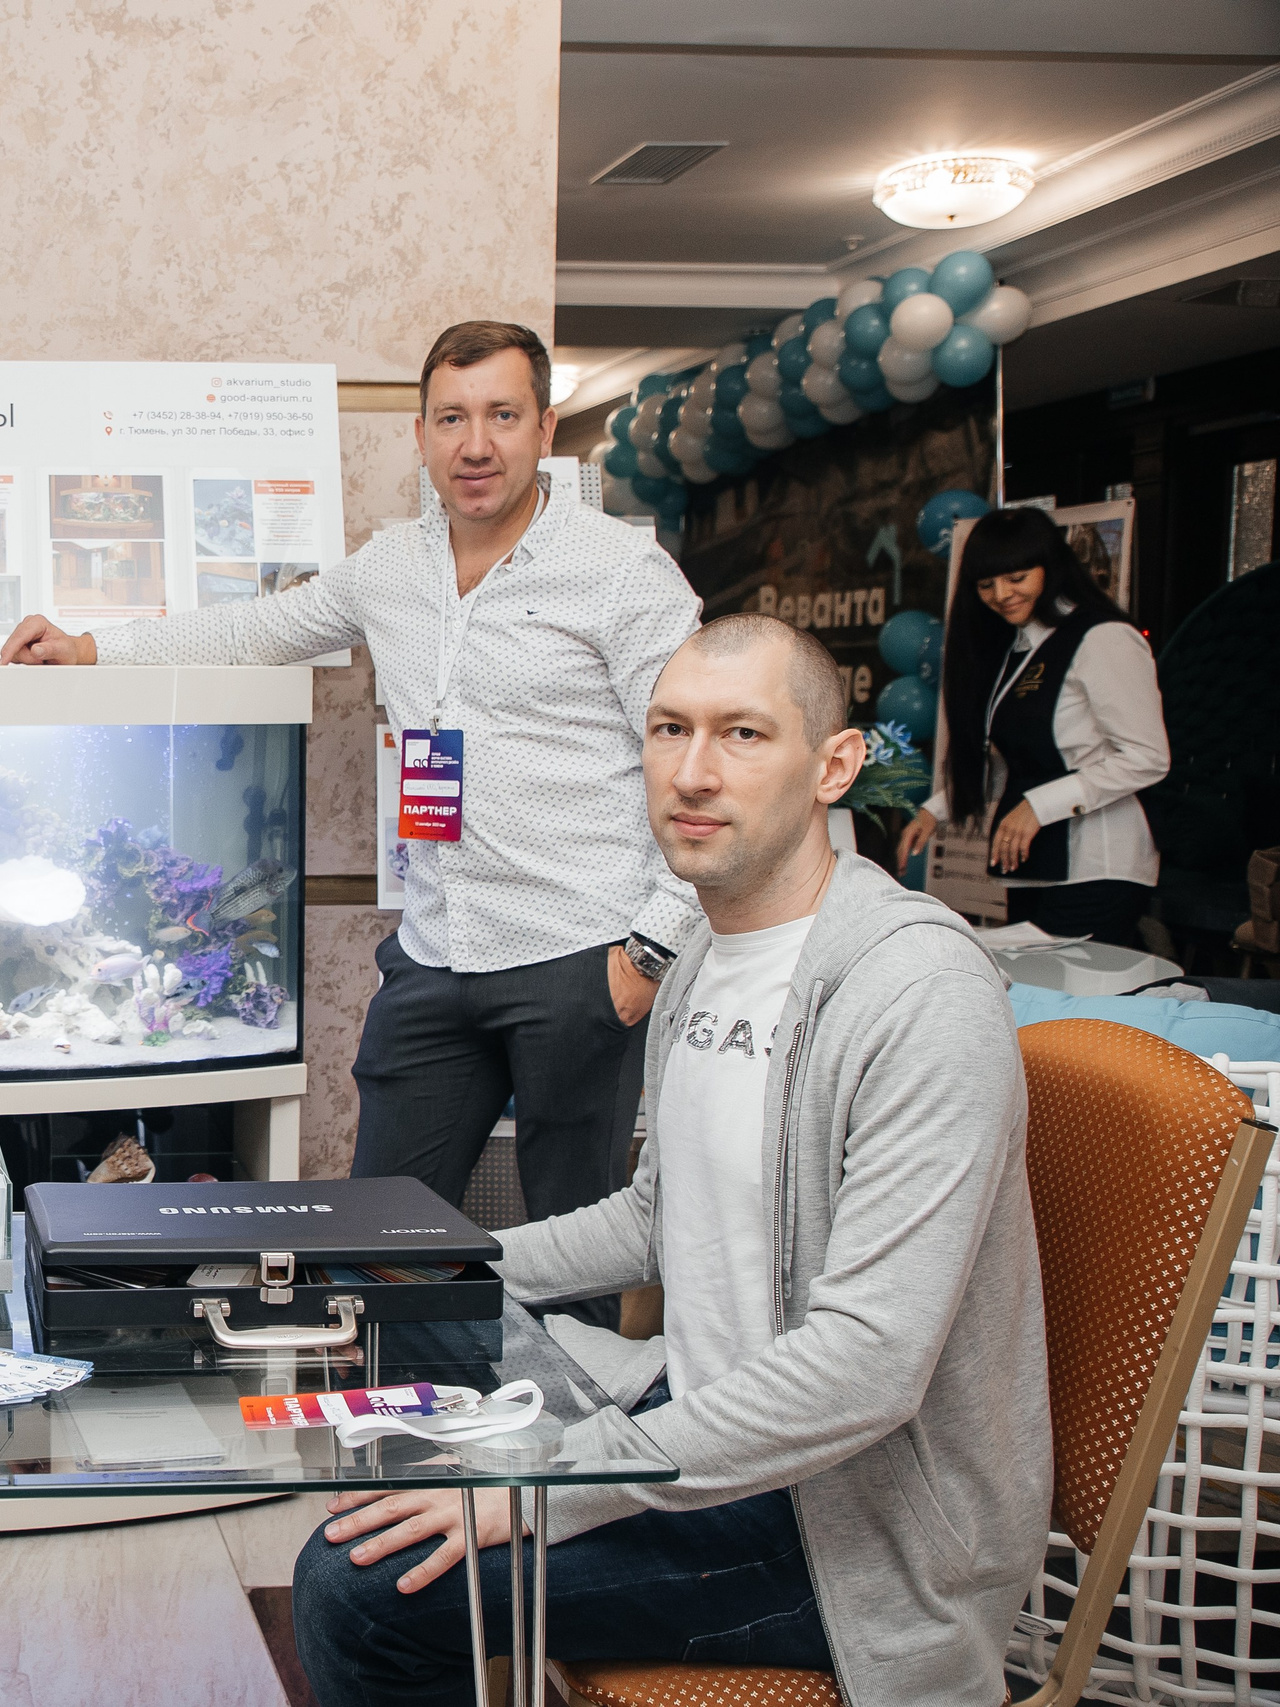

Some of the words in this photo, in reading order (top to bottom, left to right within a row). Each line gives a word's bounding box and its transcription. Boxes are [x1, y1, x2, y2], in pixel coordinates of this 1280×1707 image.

[226, 377, 312, 389] akvarium_studio
[219, 392, 313, 404] good-aquarium.ru
[132, 411, 144, 420] +7
[146, 410, 178, 421] (3452)
[180, 410, 225, 421] 28-38-94,
[228, 411, 264, 422] +7(919)
[266, 411, 314, 421] 950-36-50
[127, 426, 169, 437] Тюмень,
[171, 428, 183, 437] ул
[185, 426, 198, 436] 30
[200, 427, 216, 436] лет
[219, 426, 260, 437] Победы,
[262, 427, 277, 437] 33,
[279, 427, 306, 438] офис
[307, 427, 314, 437] 9
[403, 805, 458, 816] ПАРТНЕР
[158, 1203, 334, 1216] SAMSUNG
